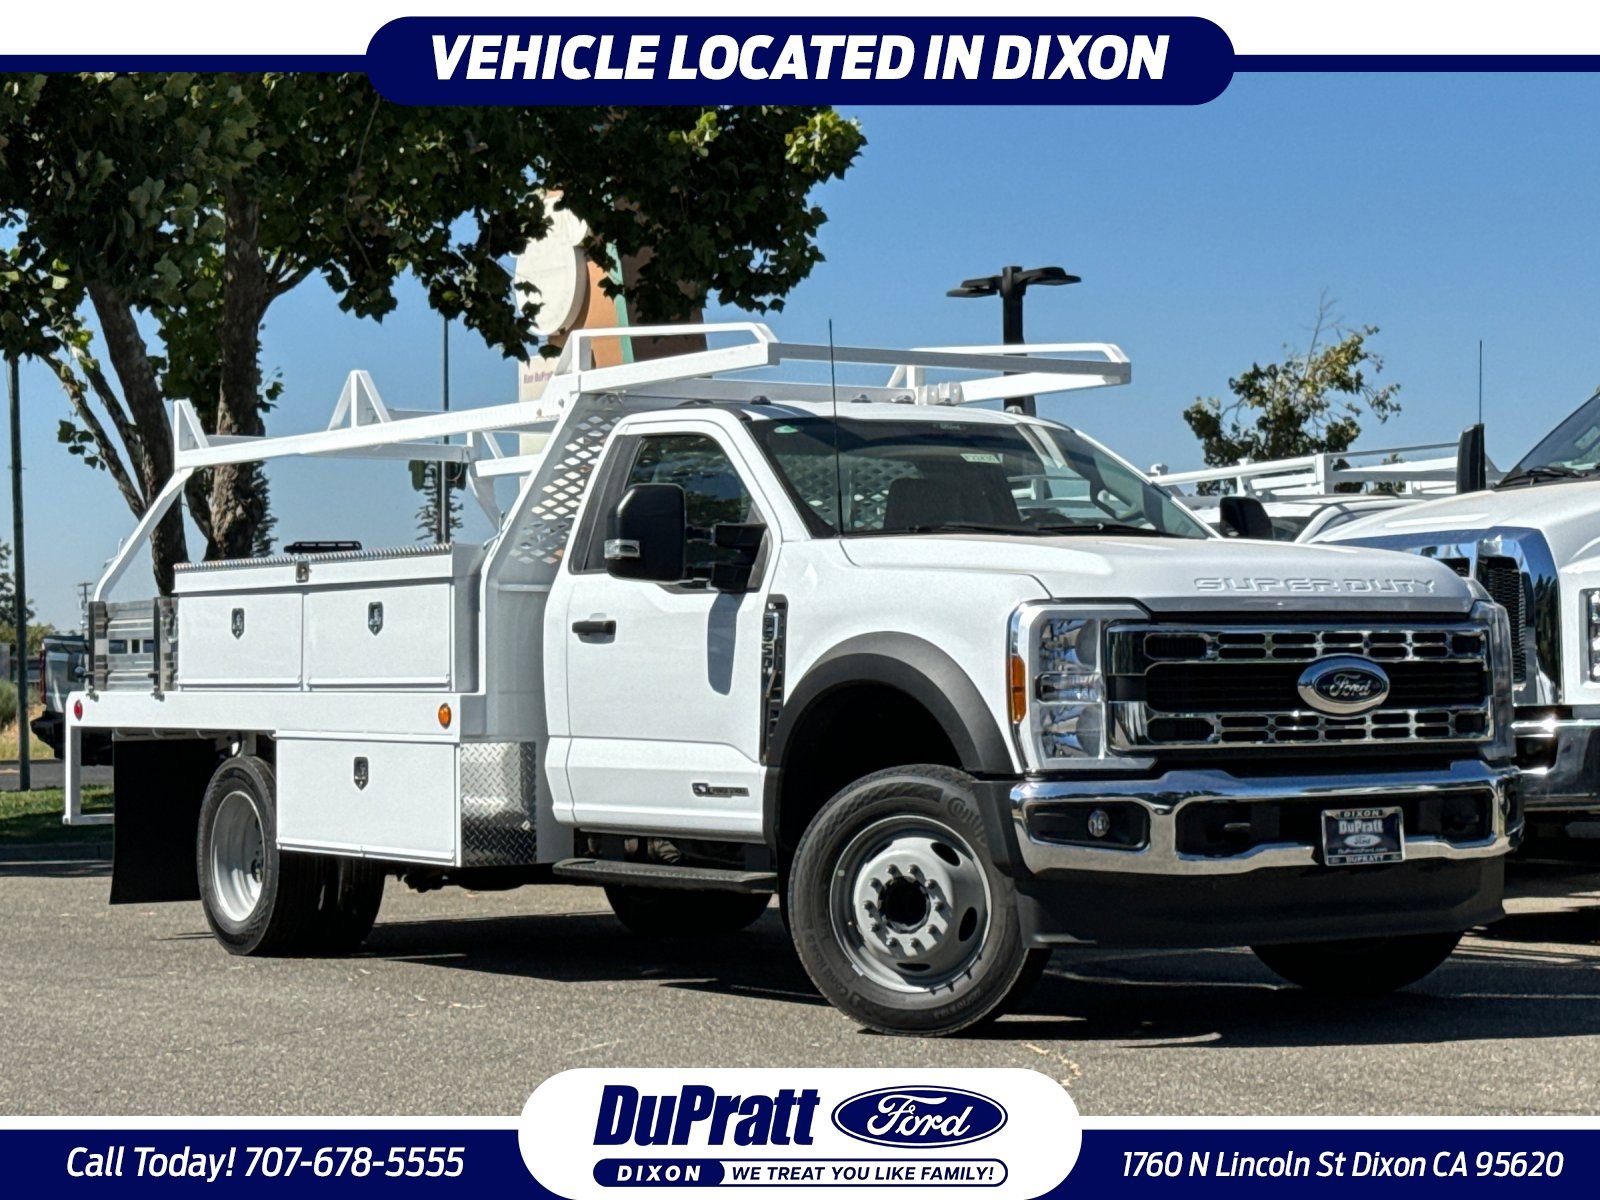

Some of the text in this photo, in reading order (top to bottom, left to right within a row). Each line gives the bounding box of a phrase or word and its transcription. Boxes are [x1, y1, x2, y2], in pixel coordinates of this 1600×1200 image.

[1194, 577, 1435, 593] SUPER DUTY
[1329, 672, 1372, 697] Ford
[1344, 809, 1380, 818] DIXON
[1338, 819, 1384, 834] DuPratt
[1345, 855, 1384, 864] DUPRATT
